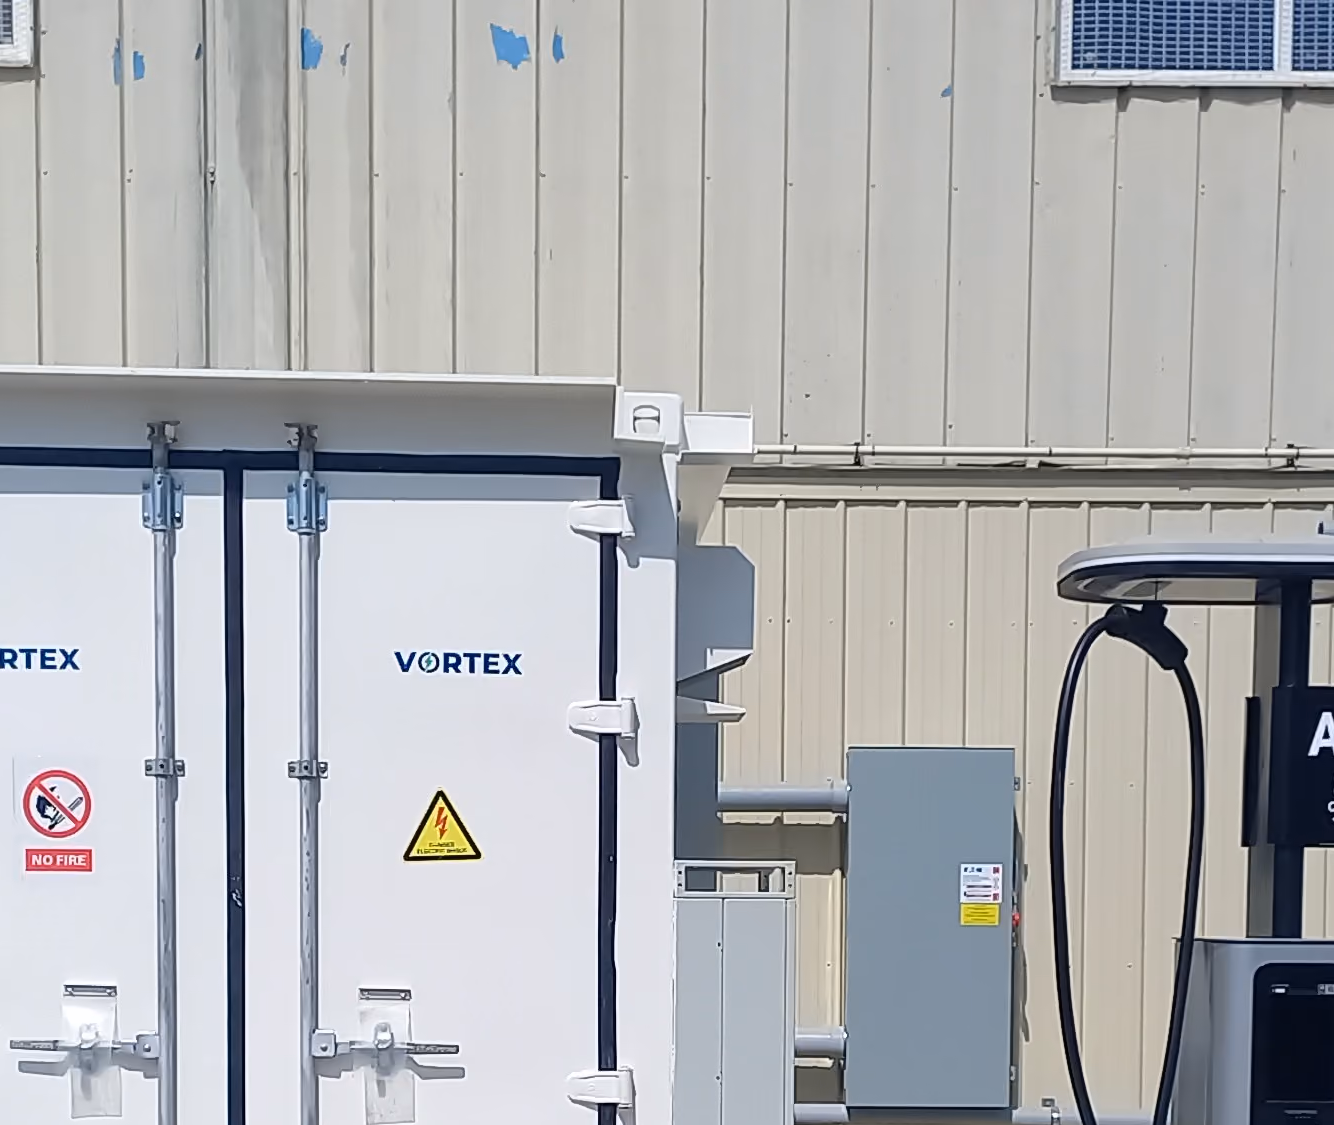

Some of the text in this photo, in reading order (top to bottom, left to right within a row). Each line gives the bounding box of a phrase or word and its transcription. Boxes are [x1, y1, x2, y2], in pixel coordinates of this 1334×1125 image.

[393, 651, 523, 676] VORTEX
[31, 854, 87, 867] NO FIRE
